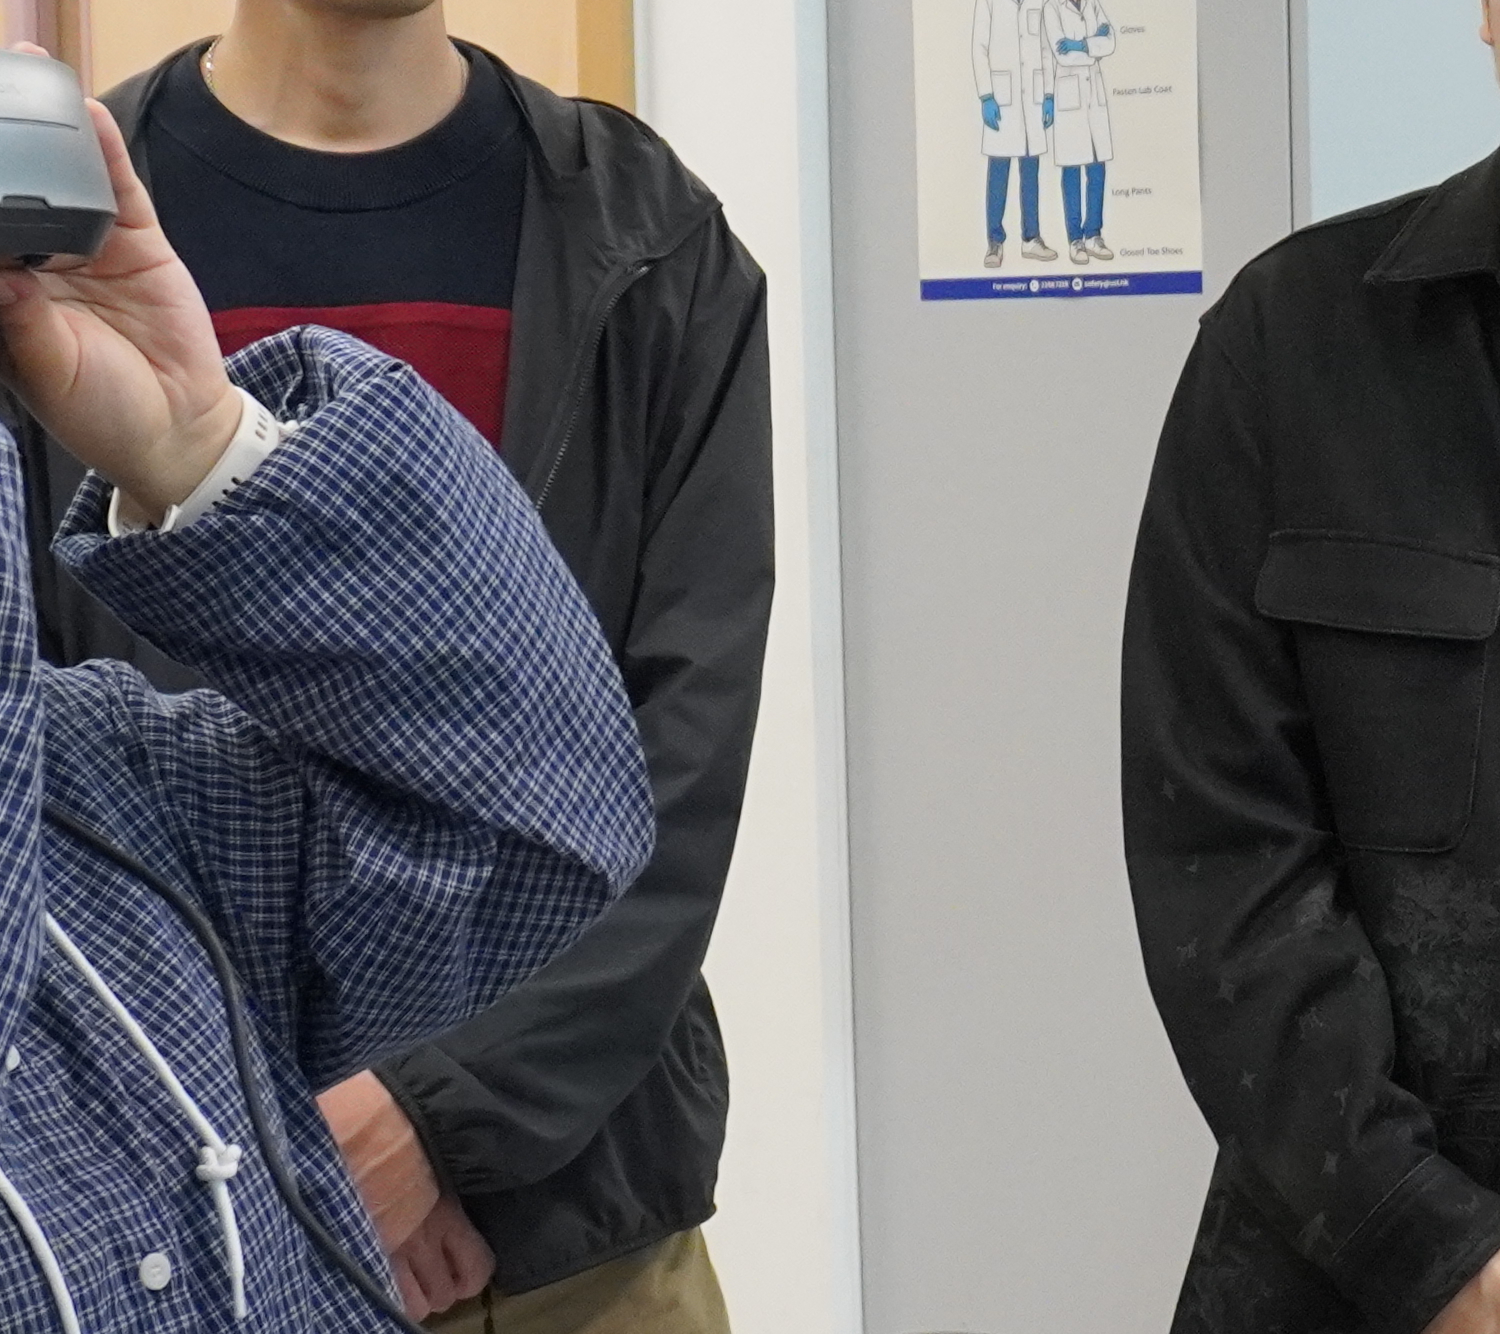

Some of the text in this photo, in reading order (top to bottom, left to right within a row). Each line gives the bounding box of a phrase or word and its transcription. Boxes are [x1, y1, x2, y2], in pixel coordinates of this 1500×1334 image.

[1120, 25, 1146, 35] Gloves
[1138, 86, 1152, 94] Lab
[1154, 85, 1173, 93] Coat
[1111, 187, 1152, 197] Long Pants
[1120, 246, 1183, 257] Closed Toe Shoes
